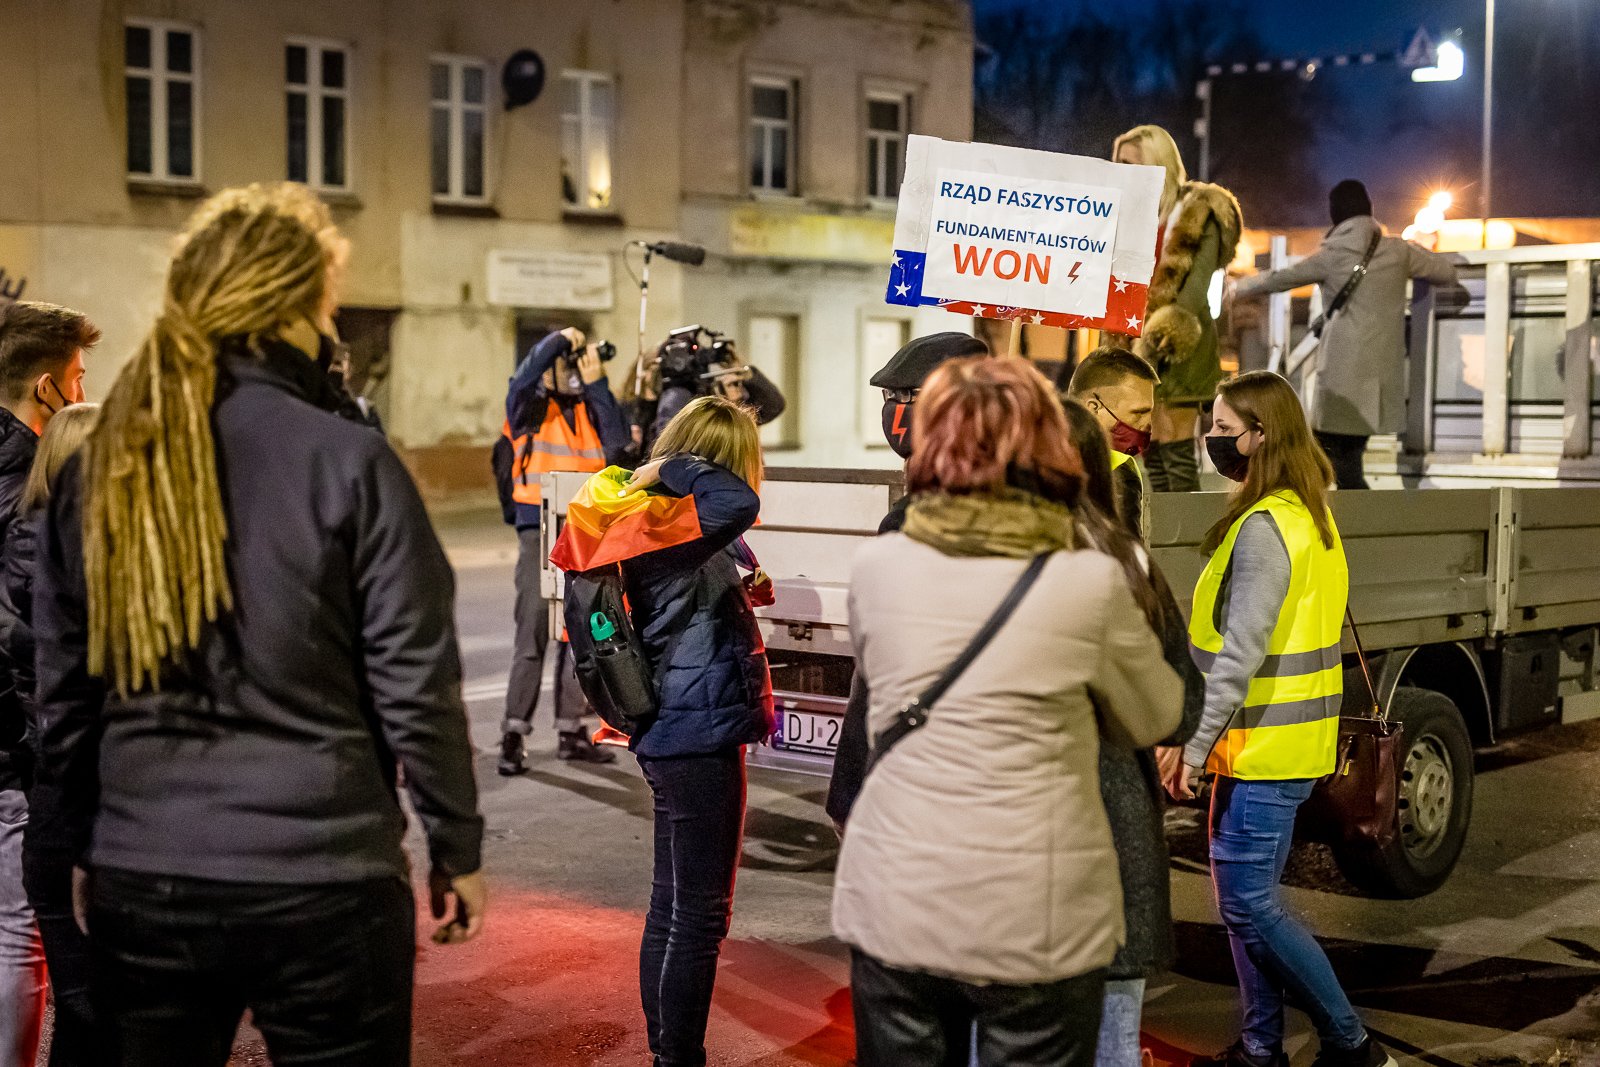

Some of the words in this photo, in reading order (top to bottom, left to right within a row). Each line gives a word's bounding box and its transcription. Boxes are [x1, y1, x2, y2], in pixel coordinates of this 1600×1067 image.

[940, 181, 992, 205] RZĄD
[997, 188, 1113, 218] FASZYSTÓW
[936, 220, 1107, 254] FUNDAMENTALISTÓW
[953, 243, 1052, 285] WON
[788, 713, 815, 744] DJ
